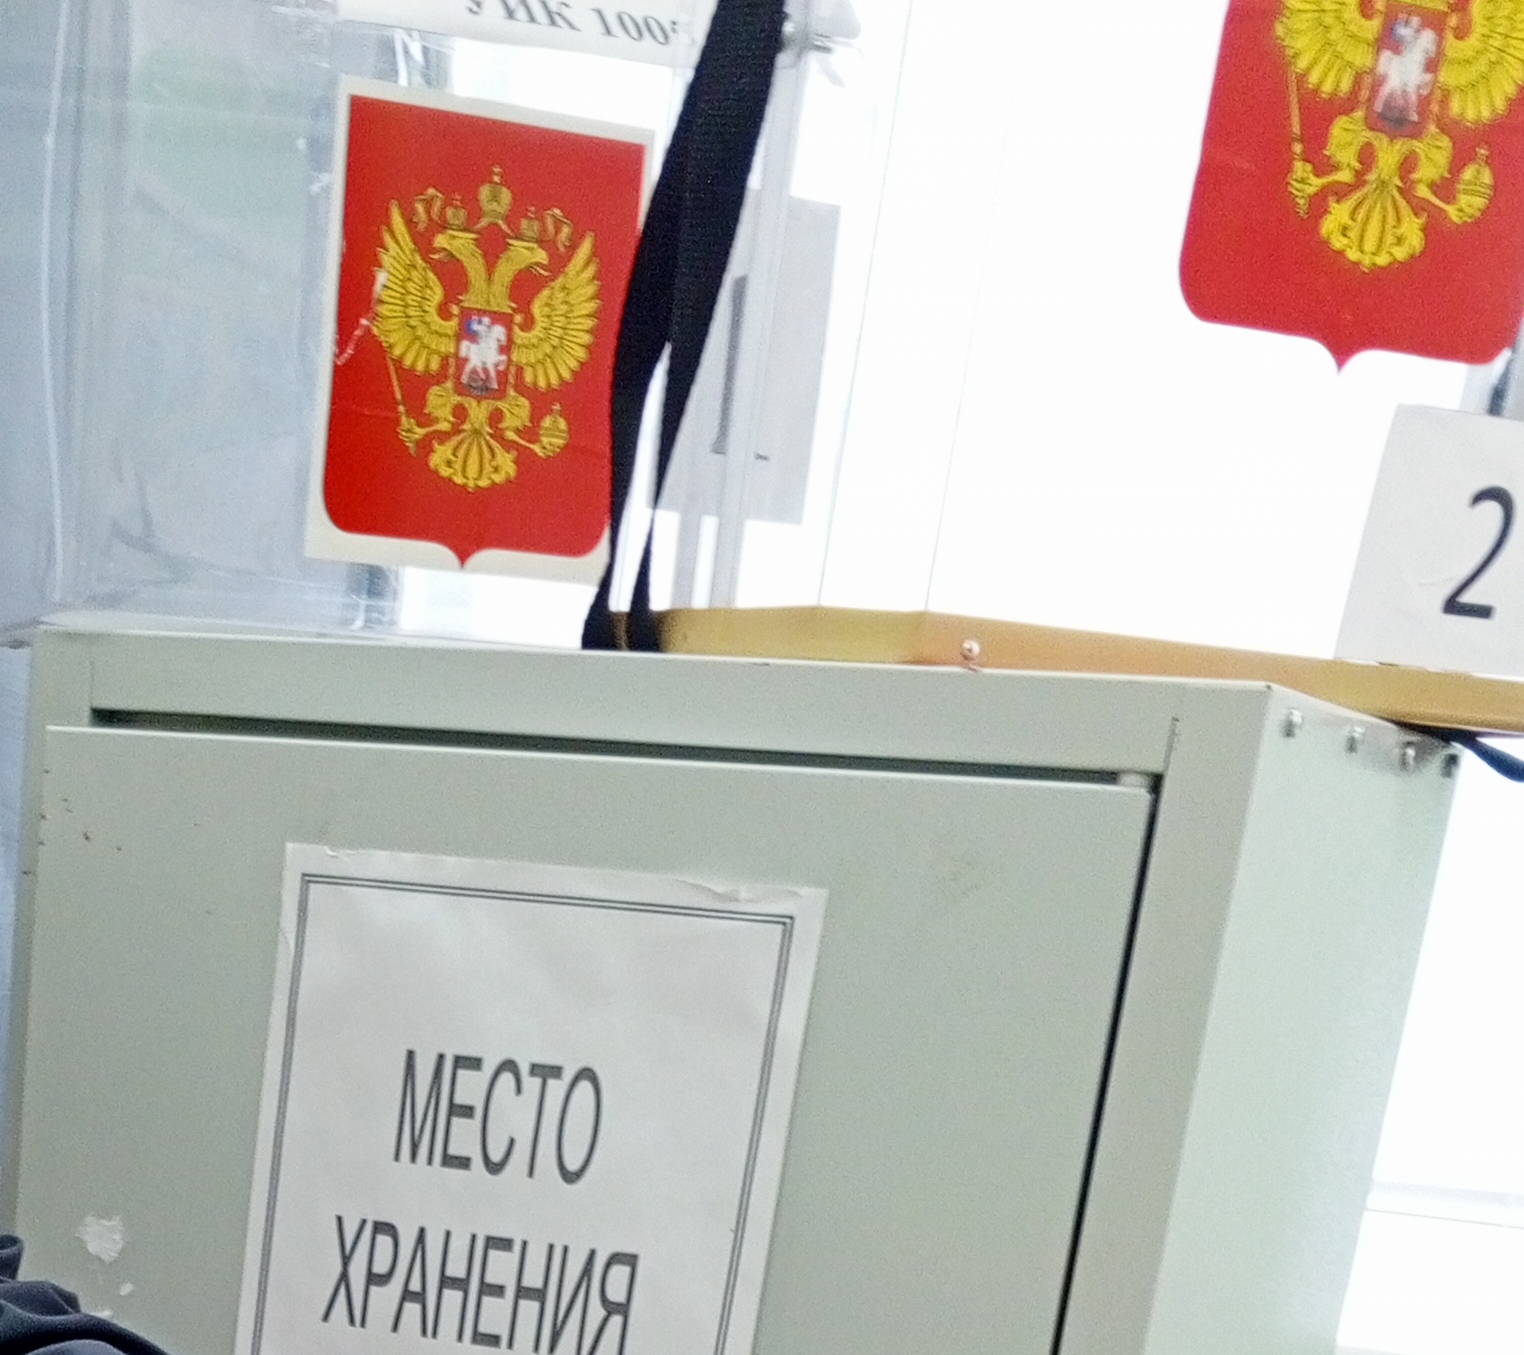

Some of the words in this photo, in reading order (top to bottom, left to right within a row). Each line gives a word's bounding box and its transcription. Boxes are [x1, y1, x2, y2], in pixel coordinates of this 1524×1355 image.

[589, 7, 682, 47] 100
[1441, 484, 1516, 620] 2
[393, 1048, 603, 1186] МЕСТО
